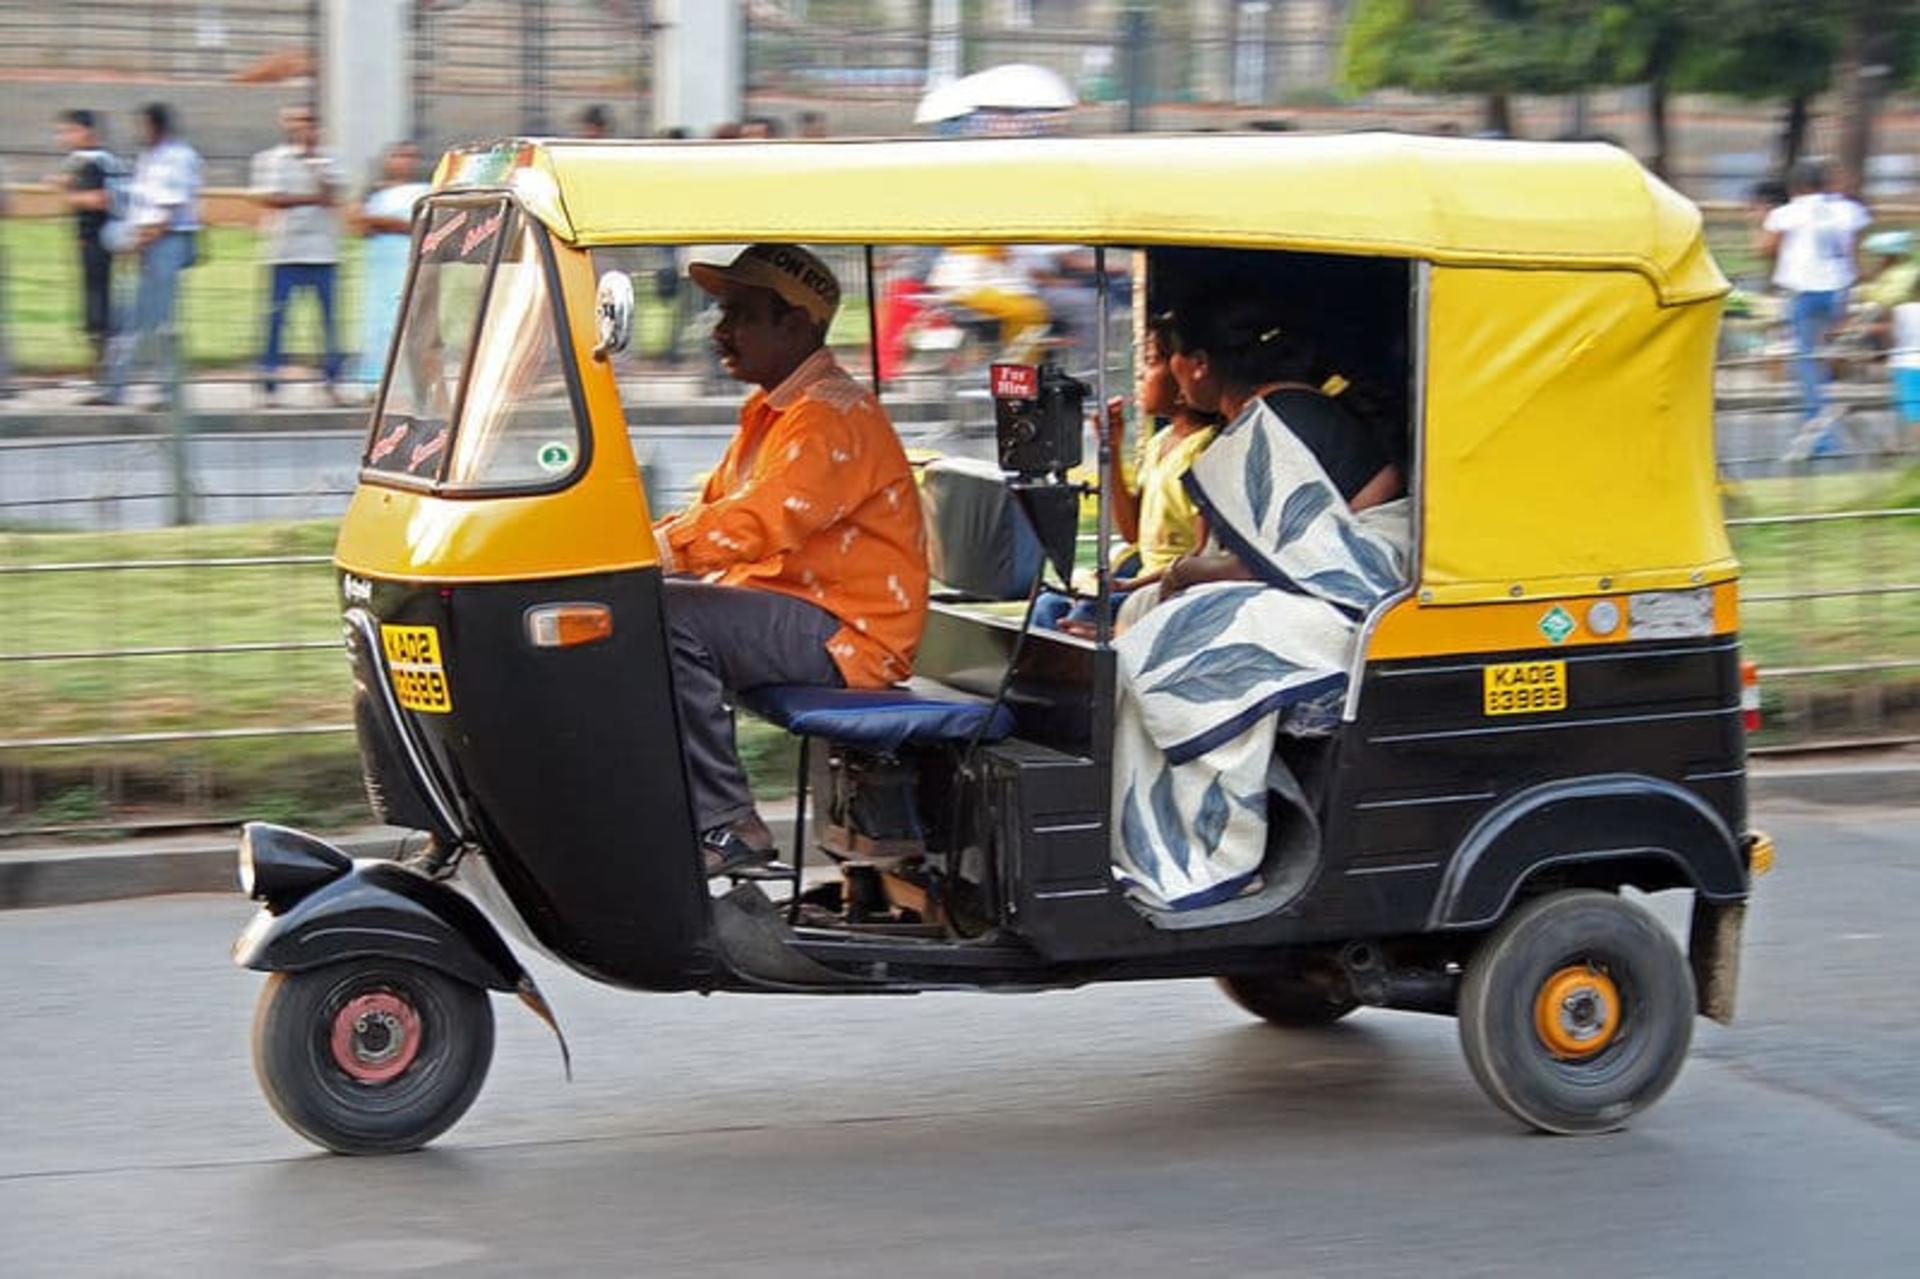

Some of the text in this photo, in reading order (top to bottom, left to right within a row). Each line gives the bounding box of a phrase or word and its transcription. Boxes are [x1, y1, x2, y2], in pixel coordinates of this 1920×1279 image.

[1000, 366, 1025, 381] For
[997, 381, 1029, 396] Hire
[1495, 665, 1557, 687] KA02
